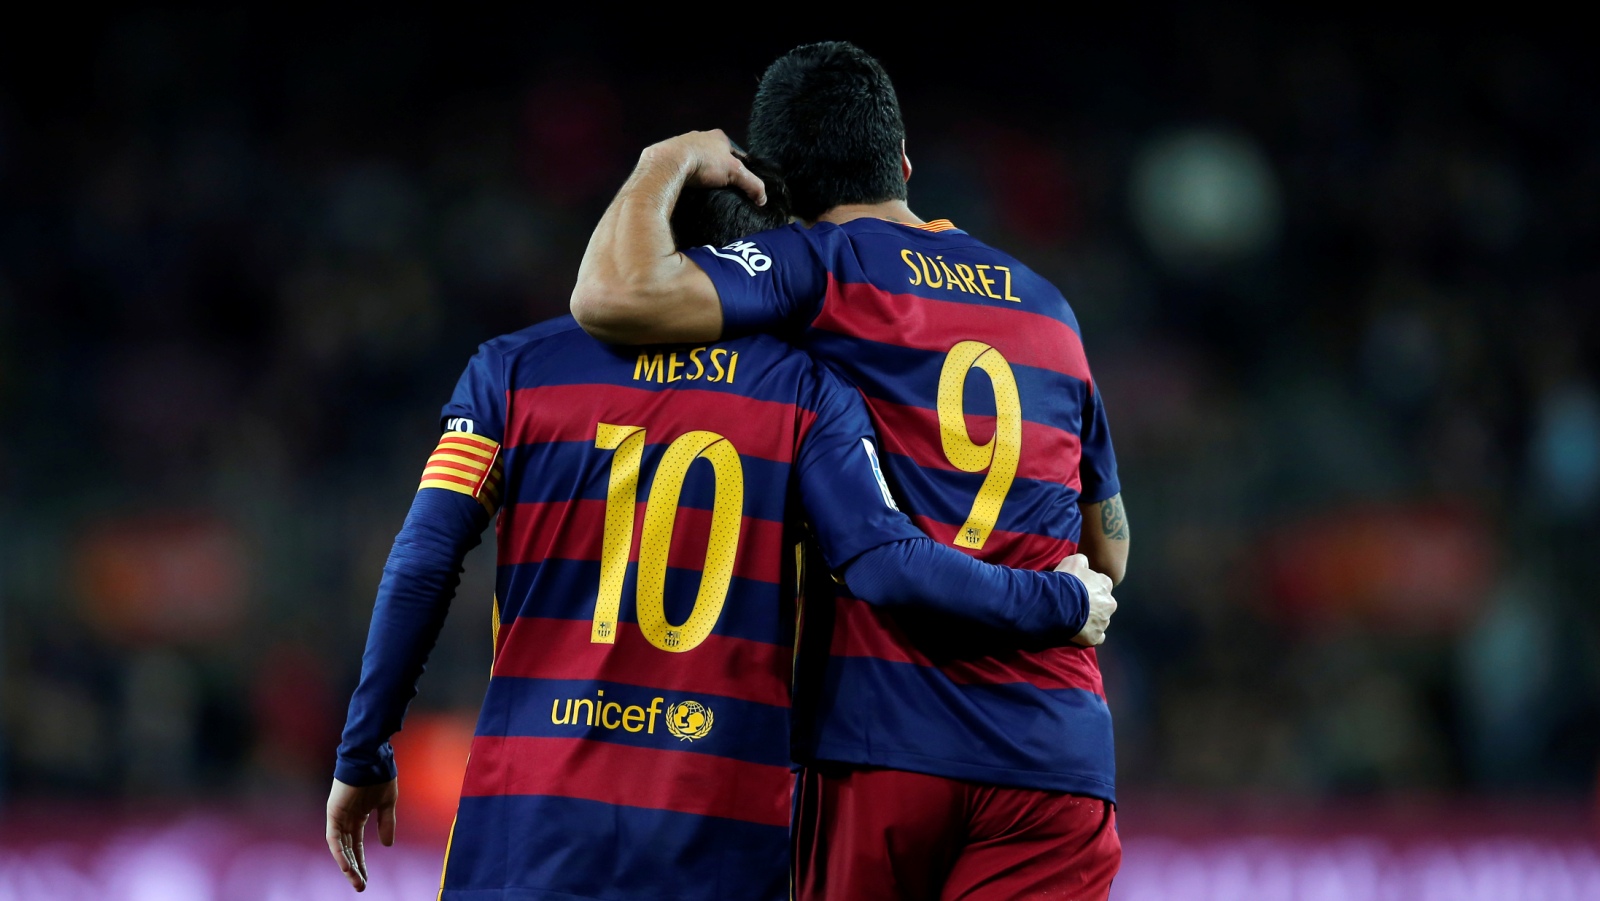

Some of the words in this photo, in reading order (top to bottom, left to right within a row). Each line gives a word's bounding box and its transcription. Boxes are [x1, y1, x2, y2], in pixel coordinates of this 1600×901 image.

[900, 249, 1021, 303] SUÁREZ
[633, 347, 739, 384] MESSI
[937, 340, 1022, 550] 9
[590, 422, 744, 653] 10
[551, 689, 664, 734] unicef
